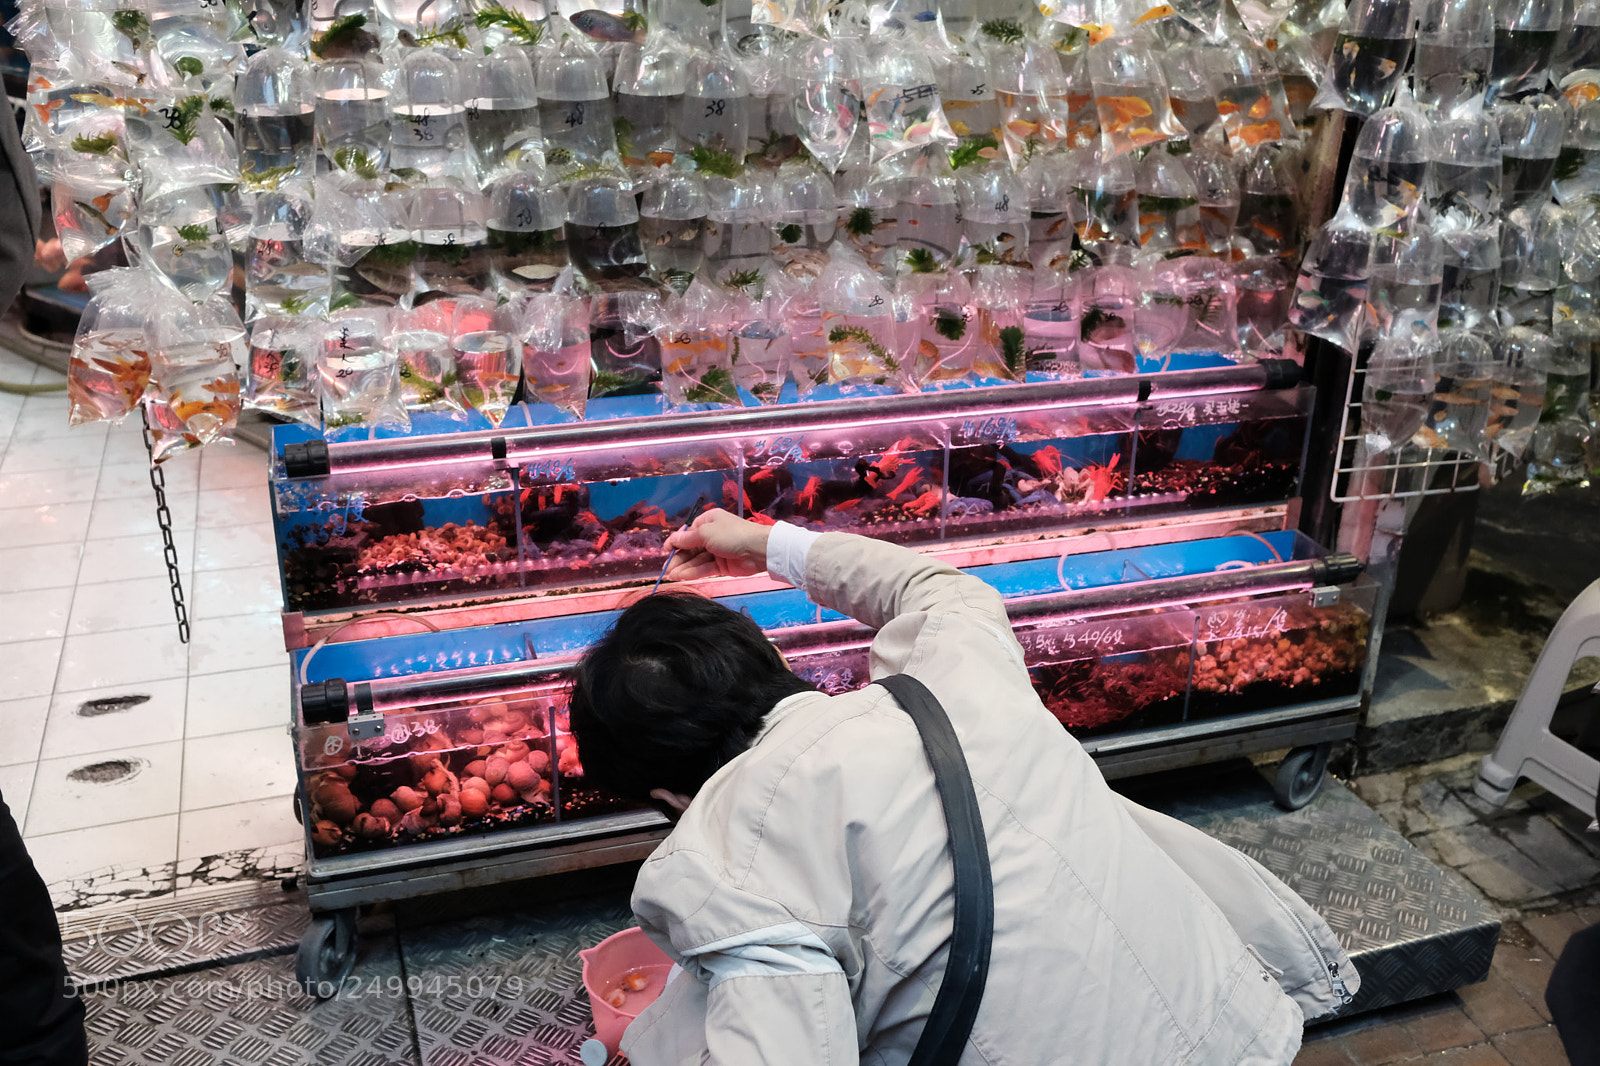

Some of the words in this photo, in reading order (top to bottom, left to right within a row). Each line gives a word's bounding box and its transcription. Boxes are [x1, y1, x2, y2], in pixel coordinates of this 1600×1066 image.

[157, 107, 184, 130] 38
[565, 102, 584, 128] 48
[704, 99, 725, 118] 38
[994, 194, 1009, 212] 48
